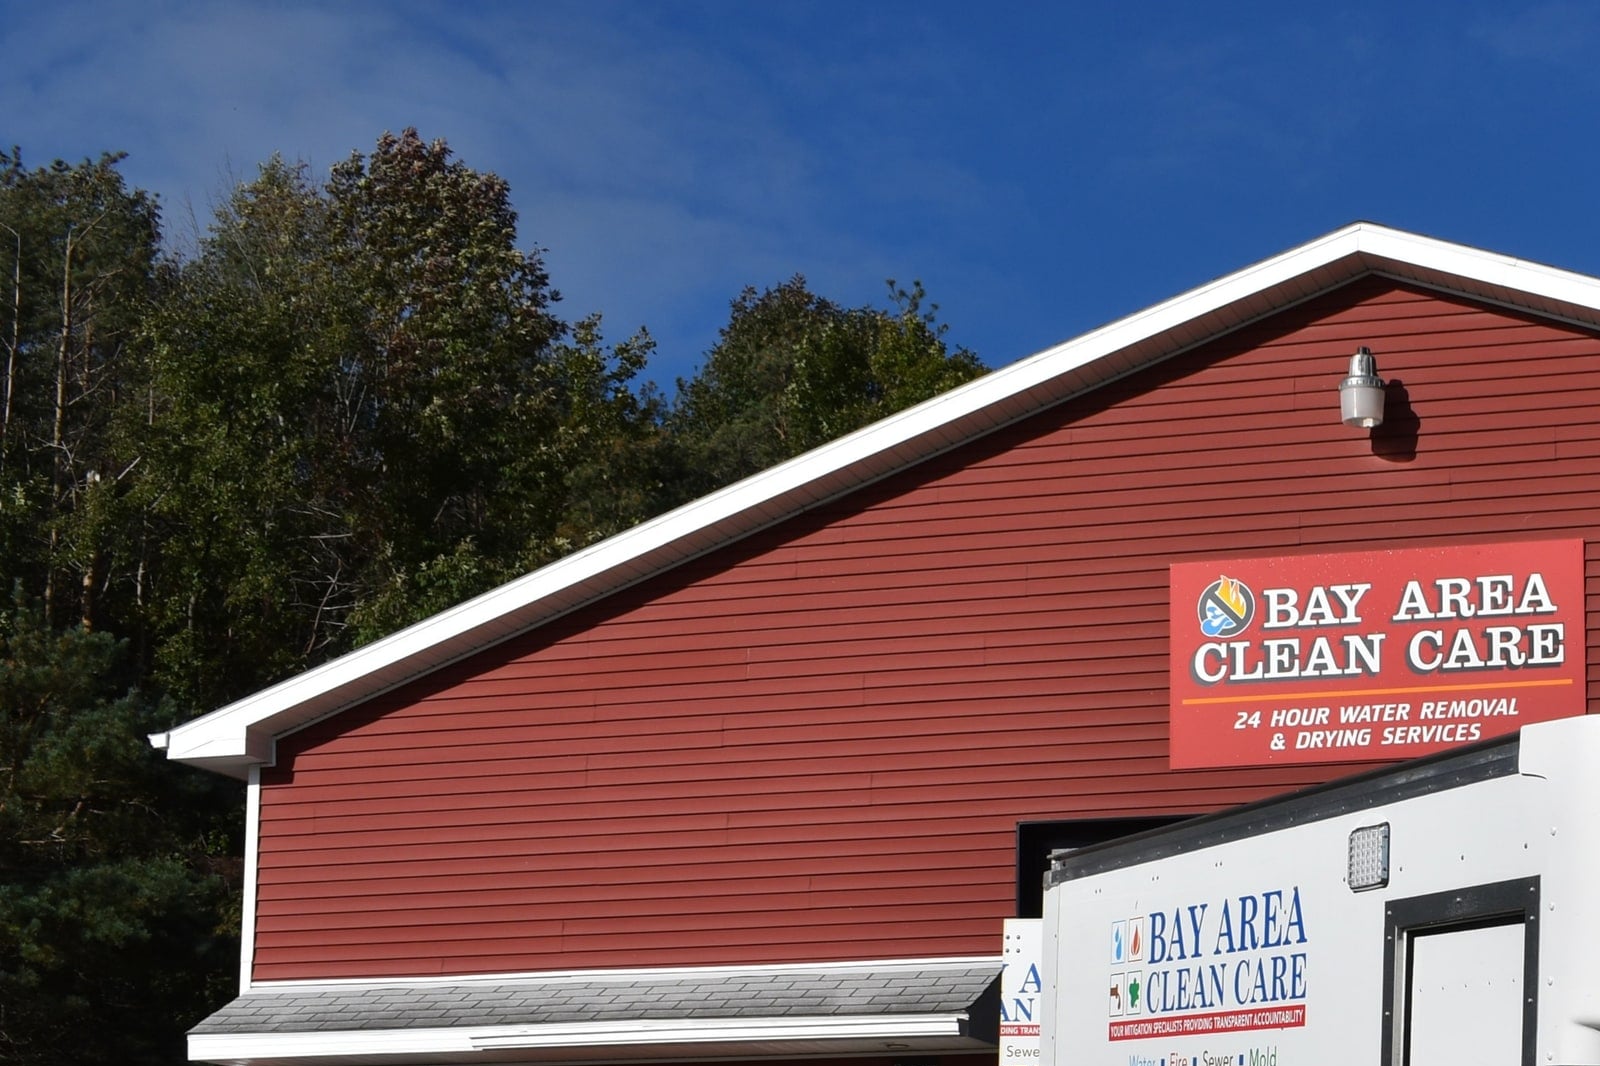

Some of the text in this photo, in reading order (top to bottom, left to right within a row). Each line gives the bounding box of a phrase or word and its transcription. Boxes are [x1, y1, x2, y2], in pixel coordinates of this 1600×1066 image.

[1262, 573, 1557, 628] BAY AREA
[1194, 623, 1564, 682] CLEAN CARE
[1233, 697, 1519, 729] 24 HOUR WATER REMOVAL
[1270, 723, 1481, 751] & DRYING SERVICES
[1148, 886, 1308, 965] BAY AREA
[1146, 953, 1307, 1014] CLEAN CARE
[1110, 1009, 1304, 1038] YOUR MITIGATION SPECIALISTS PROVIDING TRANSPARENT ACCOUNTABILITY
